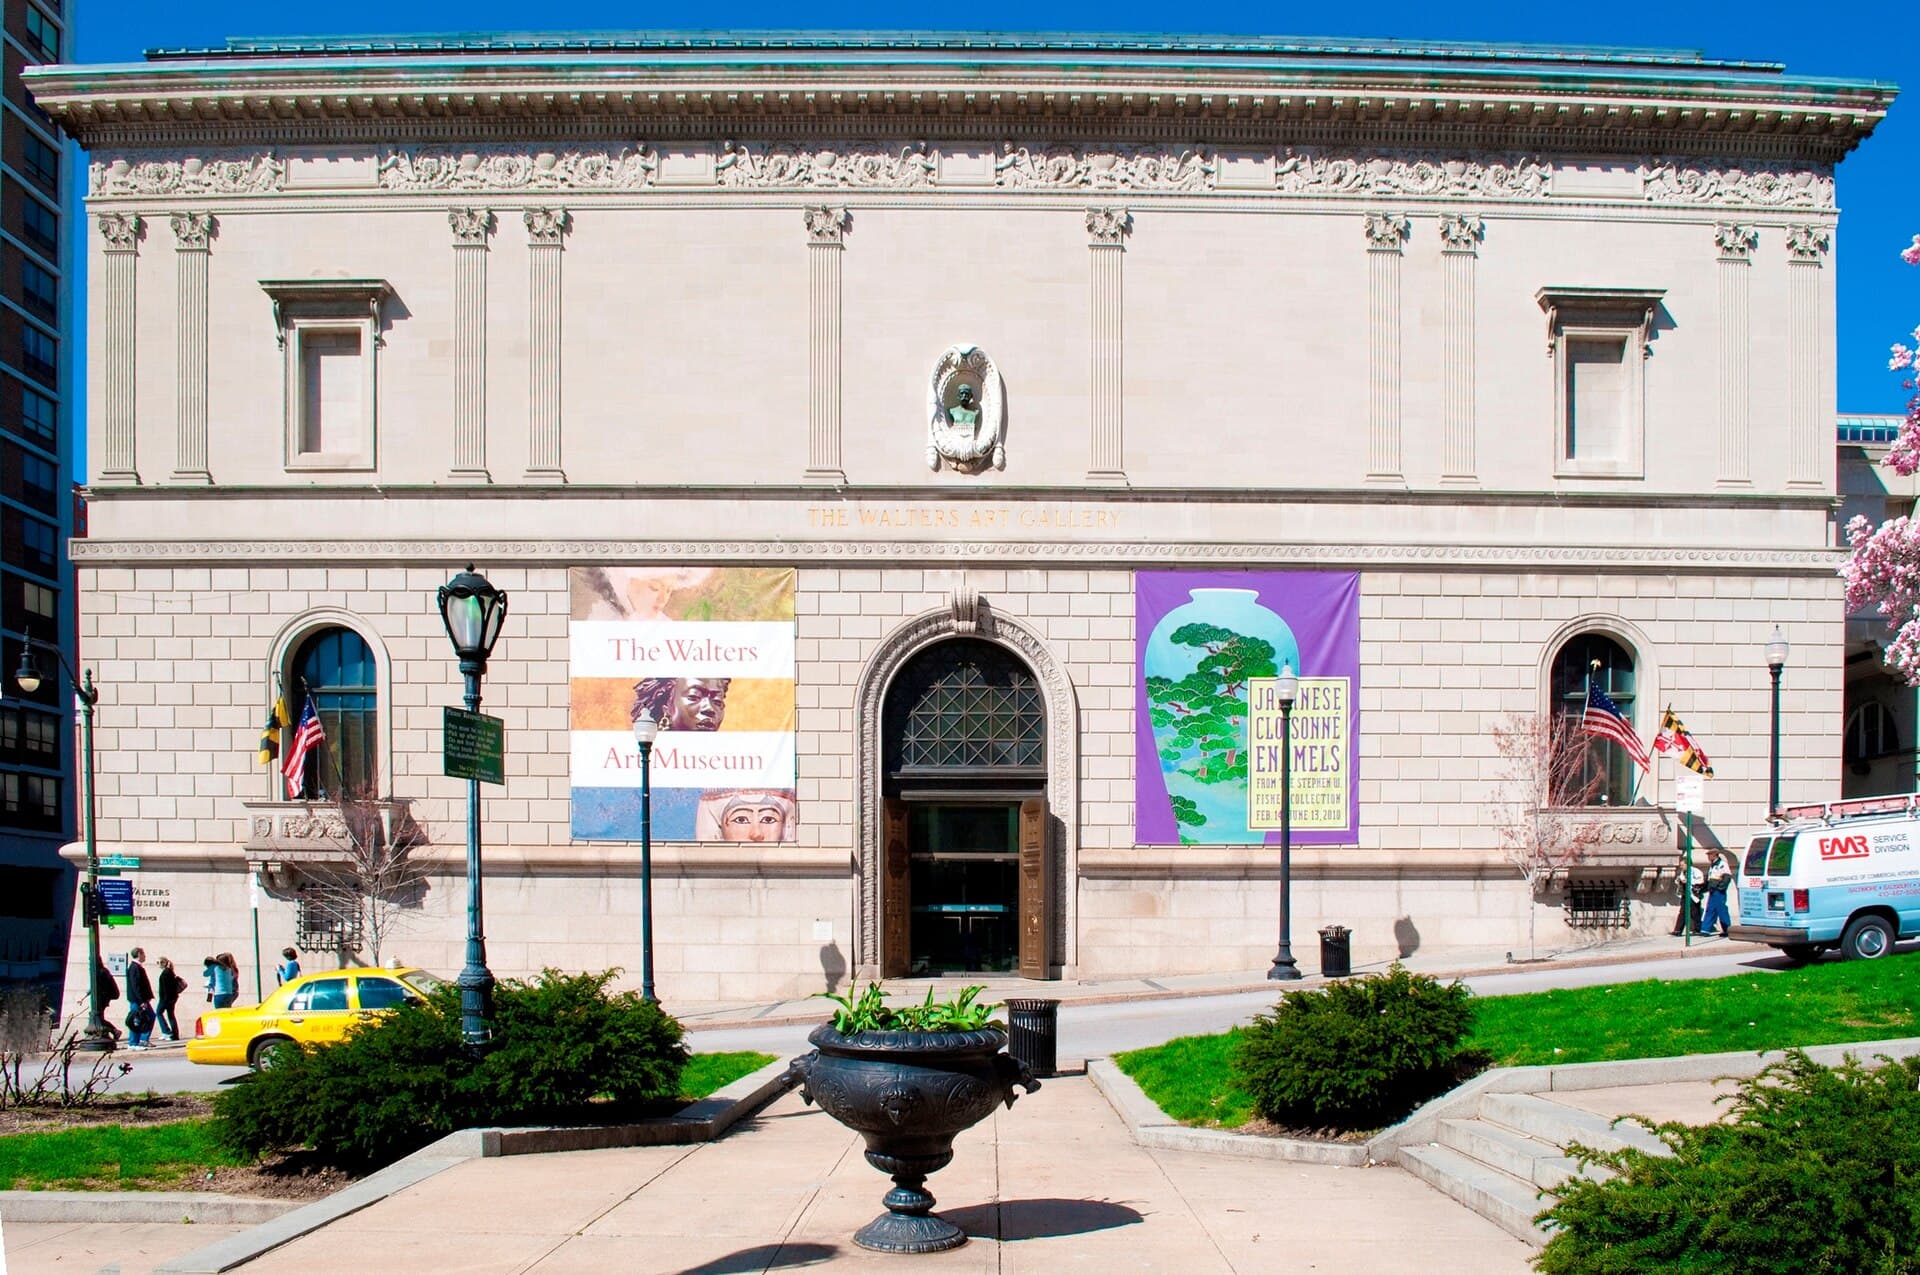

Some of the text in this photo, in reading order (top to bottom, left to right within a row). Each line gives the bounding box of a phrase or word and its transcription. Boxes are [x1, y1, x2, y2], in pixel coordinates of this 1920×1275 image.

[807, 508, 1123, 528] THE WALTERS ART GALLERY
[608, 638, 758, 662] The Walters
[1255, 687, 1341, 711] JANESE
[1256, 712, 1341, 740] CLOSONNÉ
[604, 747, 764, 770] Art Museum
[1256, 745, 1340, 773] ENMELS
[1256, 778, 1276, 789] FROM
[1297, 778, 1331, 789] STEPHEN
[1256, 794, 1341, 805] FISHE COLLECTION
[1819, 834, 1908, 856] EMR SERVICE
[1874, 844, 1910, 854] DIVISION
[260, 1018, 280, 1030] 904
